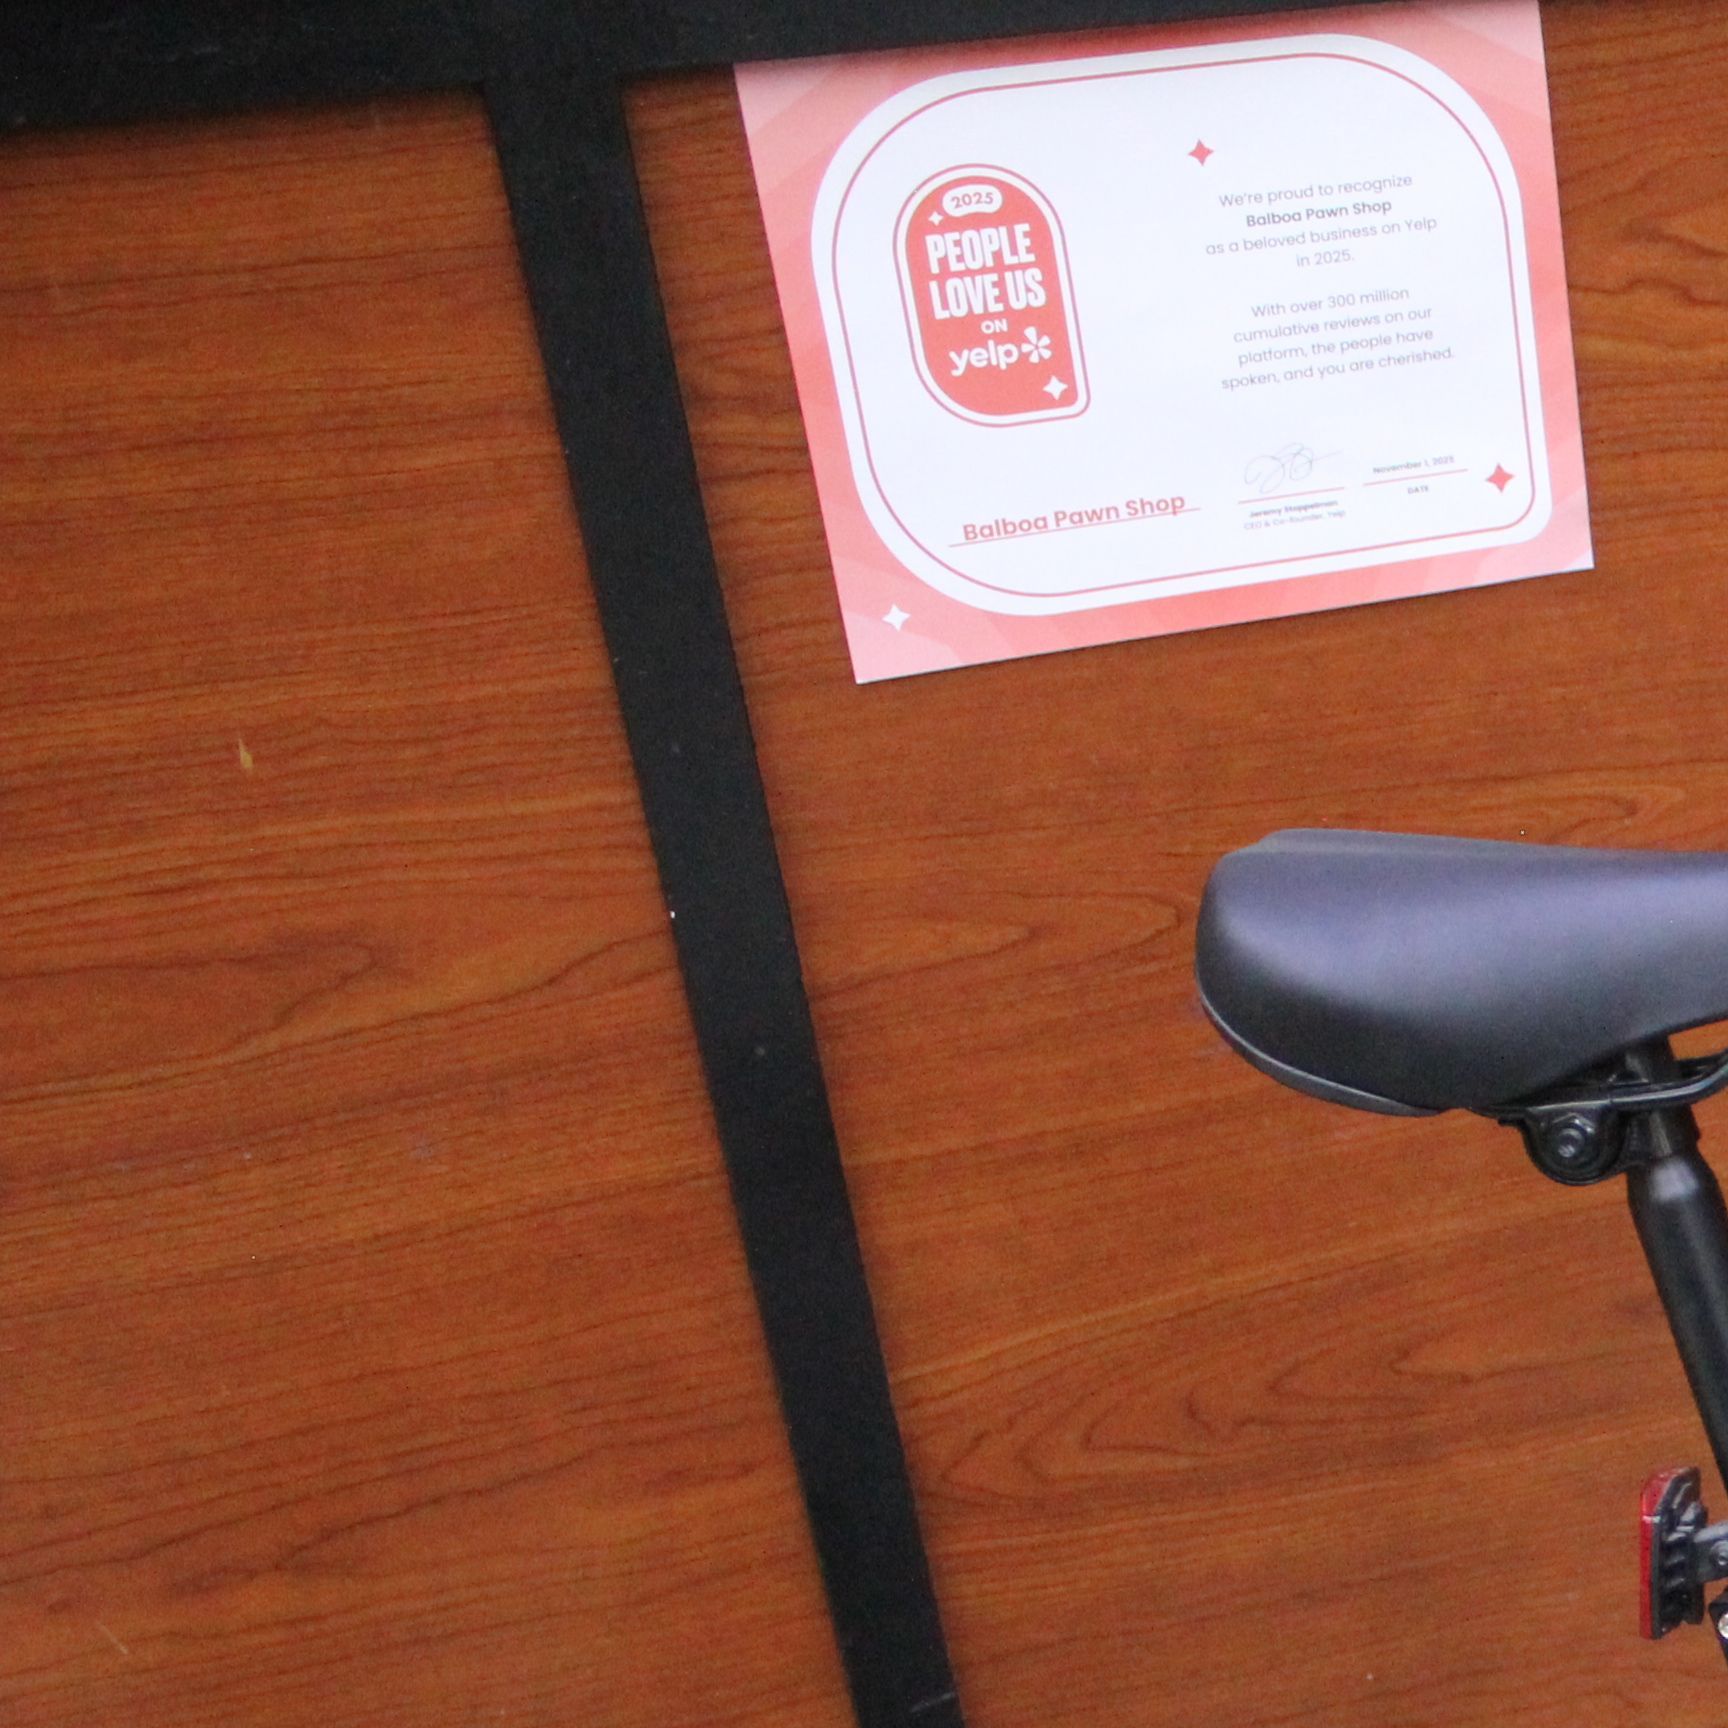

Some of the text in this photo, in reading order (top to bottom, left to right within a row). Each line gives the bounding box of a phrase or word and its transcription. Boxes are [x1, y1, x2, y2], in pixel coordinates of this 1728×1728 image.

[951, 192, 994, 209] 2025
[1219, 174, 1413, 207] We're proud to recognize
[1246, 200, 1392, 228] Balboa Pawn Shop
[925, 223, 1037, 275] PEOPLE
[1206, 216, 1437, 255] as a beloved business on Yelp
[1296, 248, 1355, 267] in 2025.
[929, 267, 1047, 320] LOVE US
[1251, 288, 1409, 317] With over 300 million
[980, 318, 1009, 334] ON
[1233, 308, 1432, 343] cumulative reviews on our
[949, 339, 1020, 377] yelp
[1238, 329, 1433, 368] platform, the people have
[1221, 346, 1454, 392] spoken, and you are cherished.
[962, 496, 1186, 541] Balboa Pawn Shop
